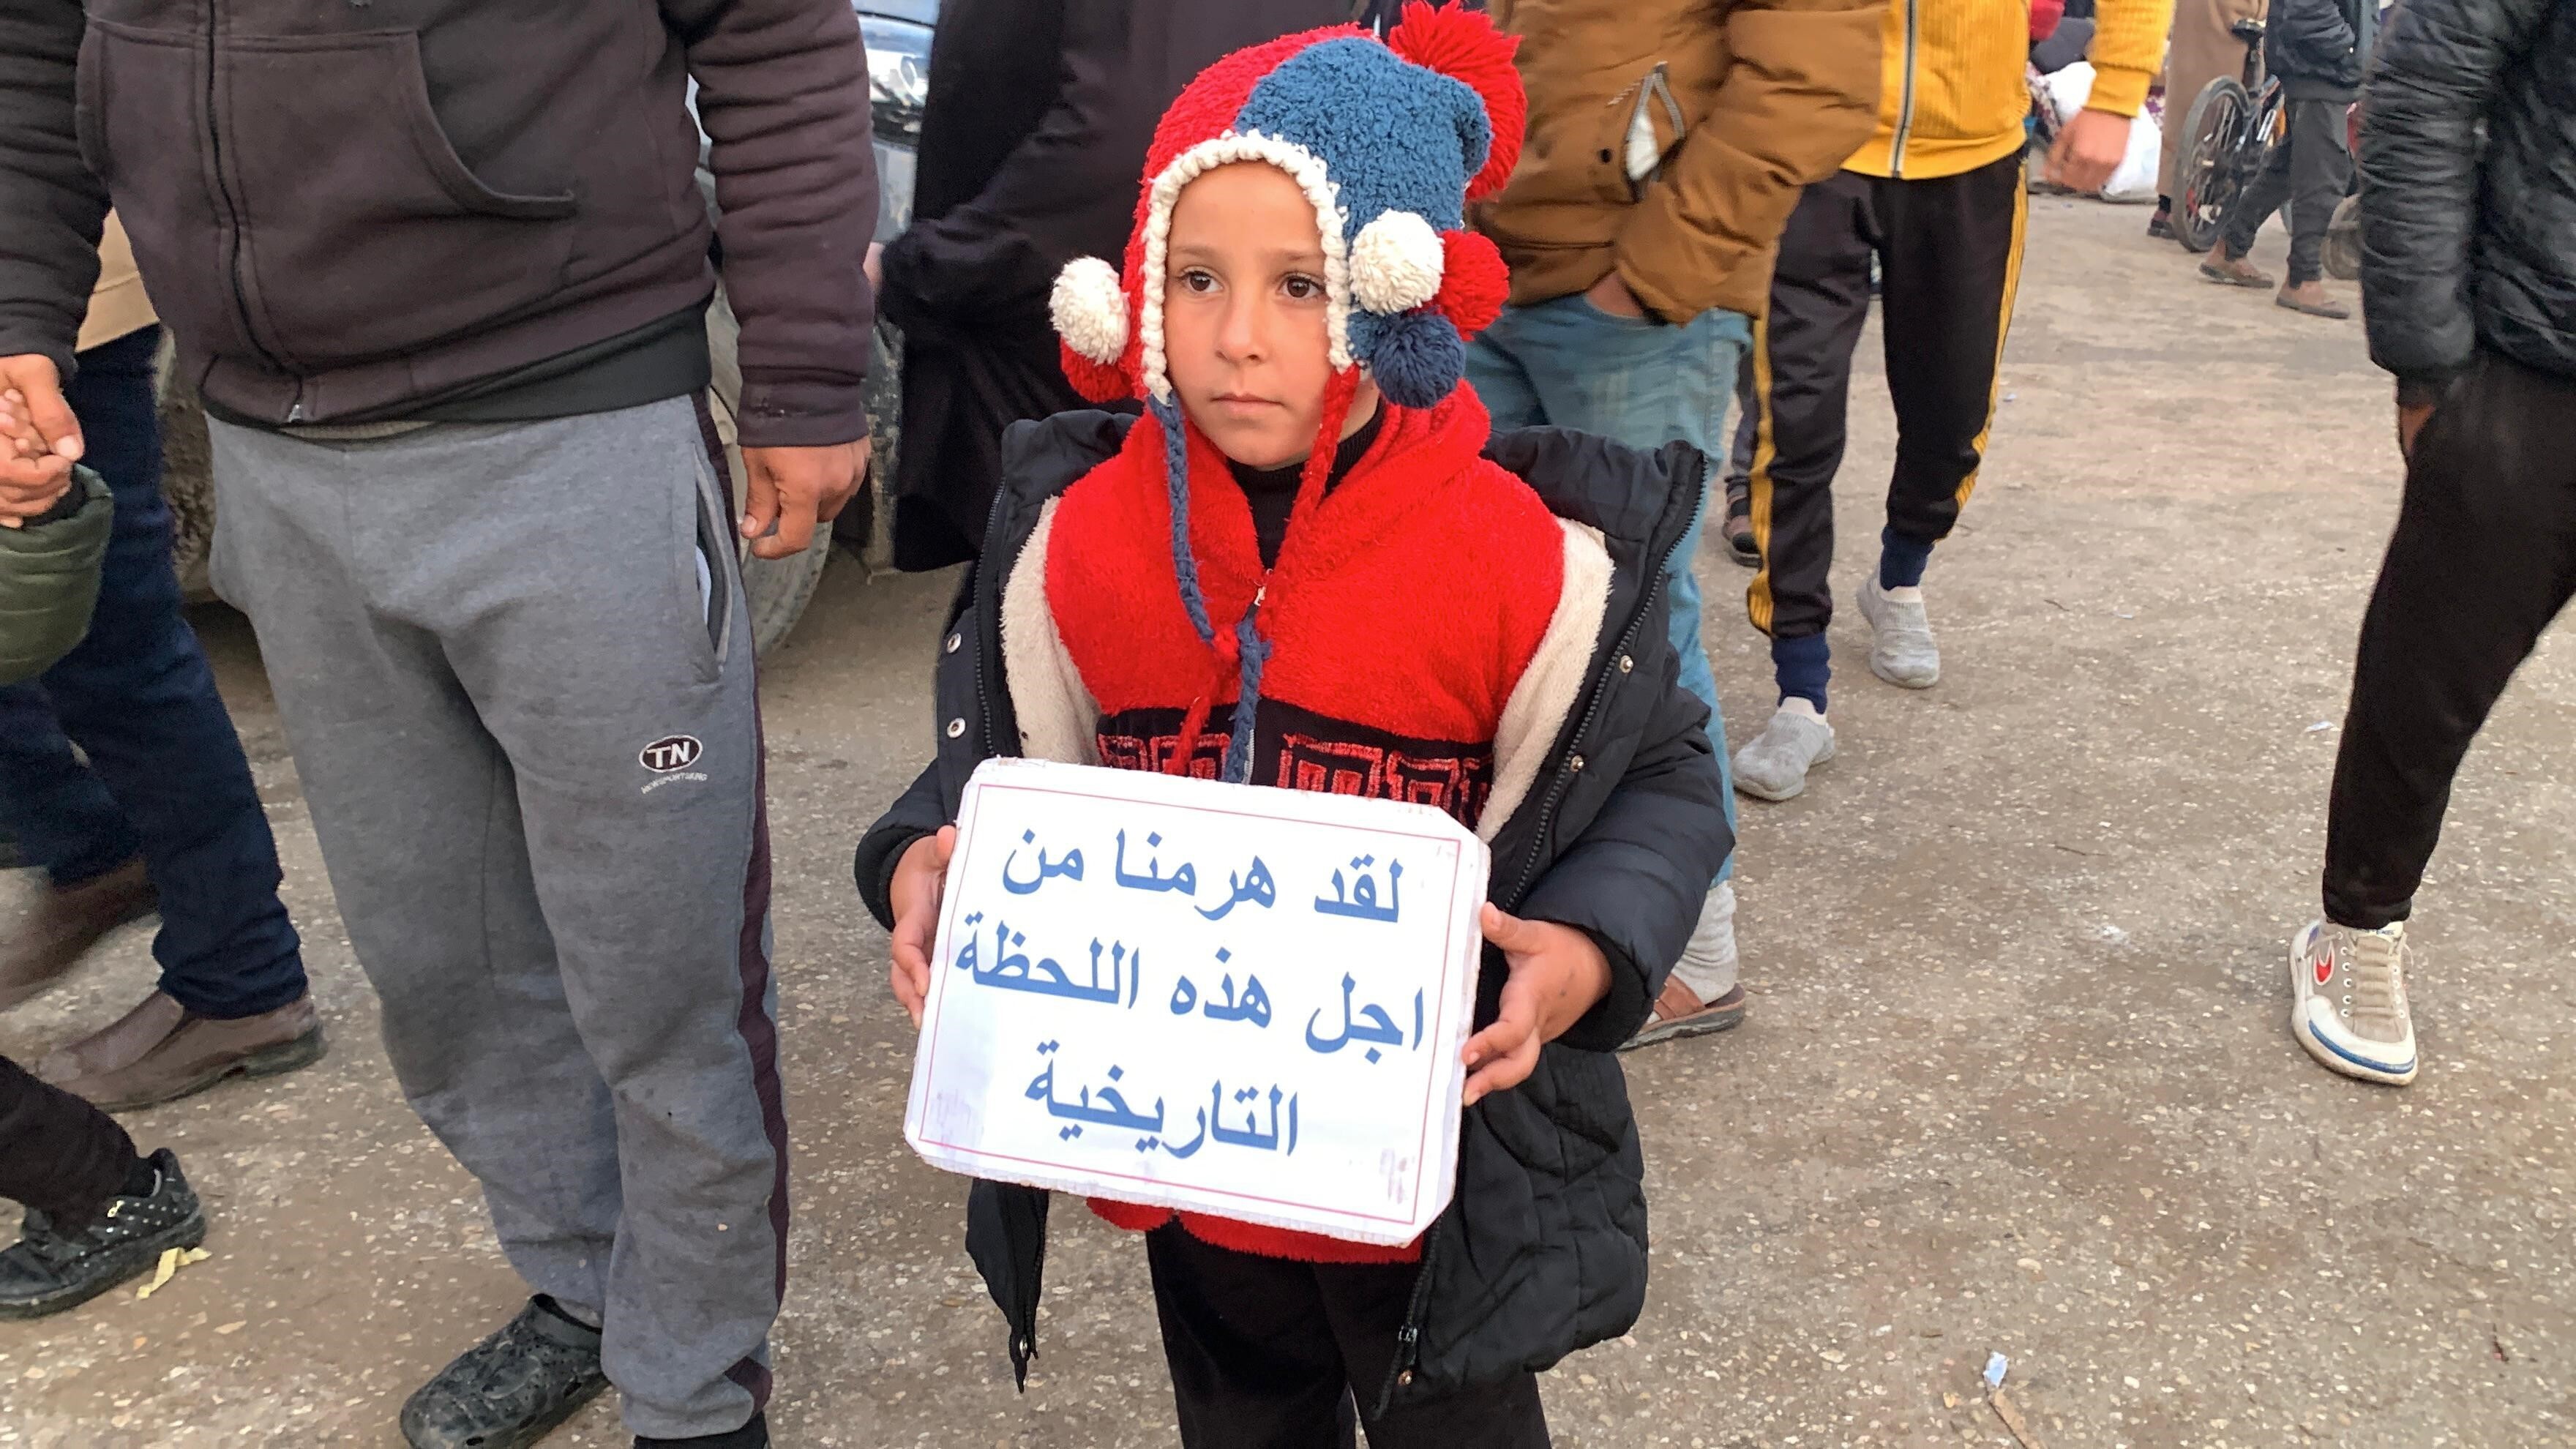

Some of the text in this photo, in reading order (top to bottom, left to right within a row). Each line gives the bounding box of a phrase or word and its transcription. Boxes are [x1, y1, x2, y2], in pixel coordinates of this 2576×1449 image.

[646, 741, 690, 768] TN
[1002, 828, 1404, 924] لقد هرمنا من
[955, 911, 1424, 1064] اجل هذه اللحظة
[1024, 1038, 1300, 1160] التاريخية
